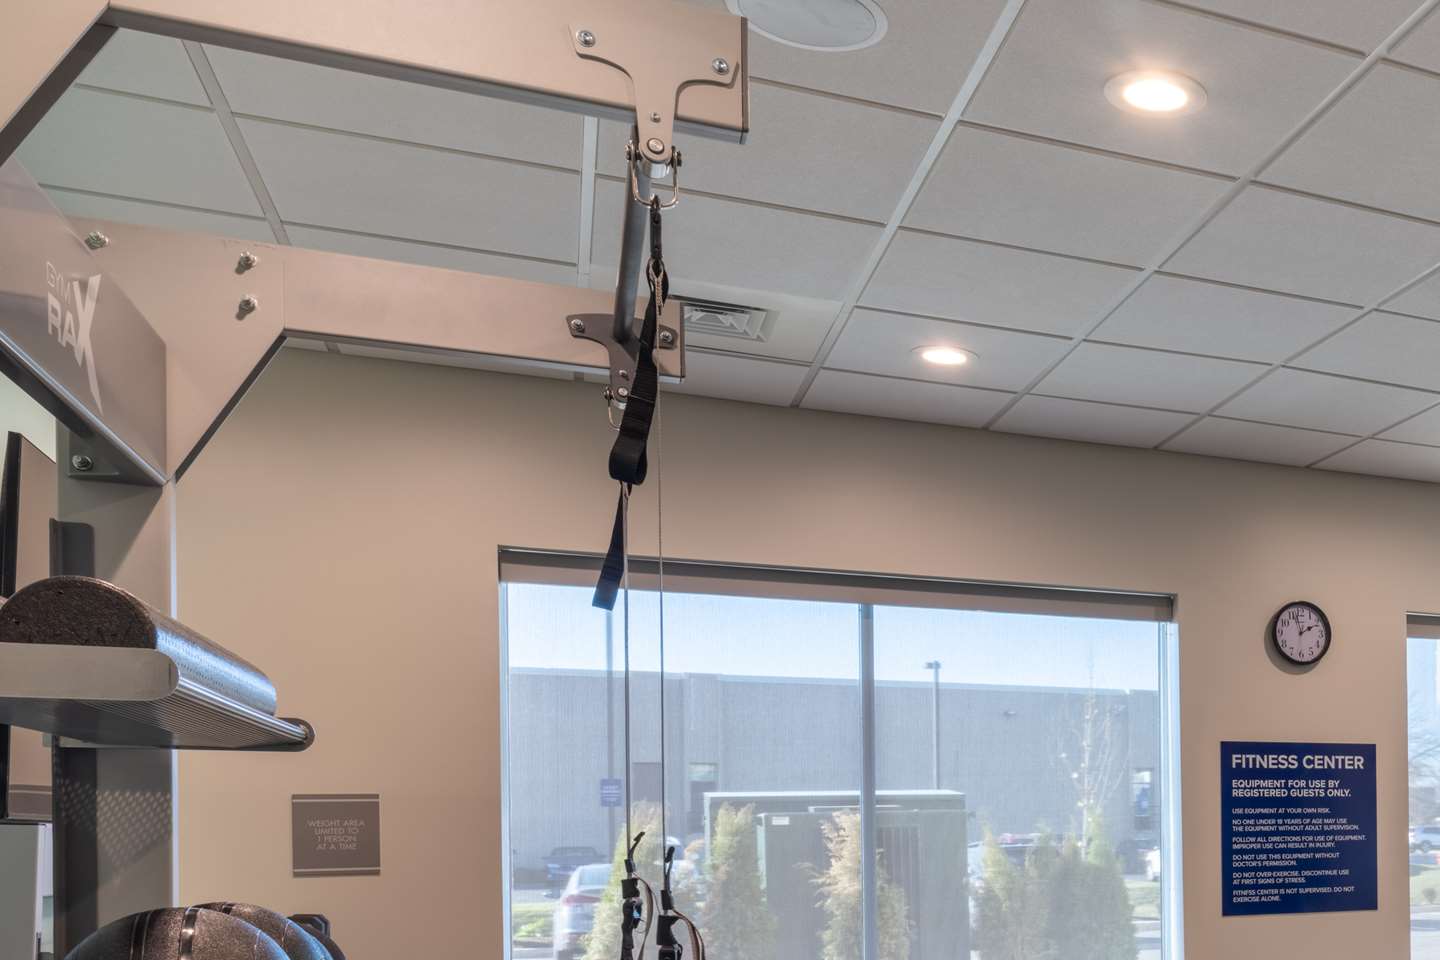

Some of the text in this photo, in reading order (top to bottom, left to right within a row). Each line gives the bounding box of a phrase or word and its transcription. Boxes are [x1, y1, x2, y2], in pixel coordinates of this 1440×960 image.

[47, 274, 103, 417] RAX
[1232, 754, 1364, 770] FITNESS CENTER
[1232, 789, 1351, 797] REGISTERED GUESTS ONLY.
